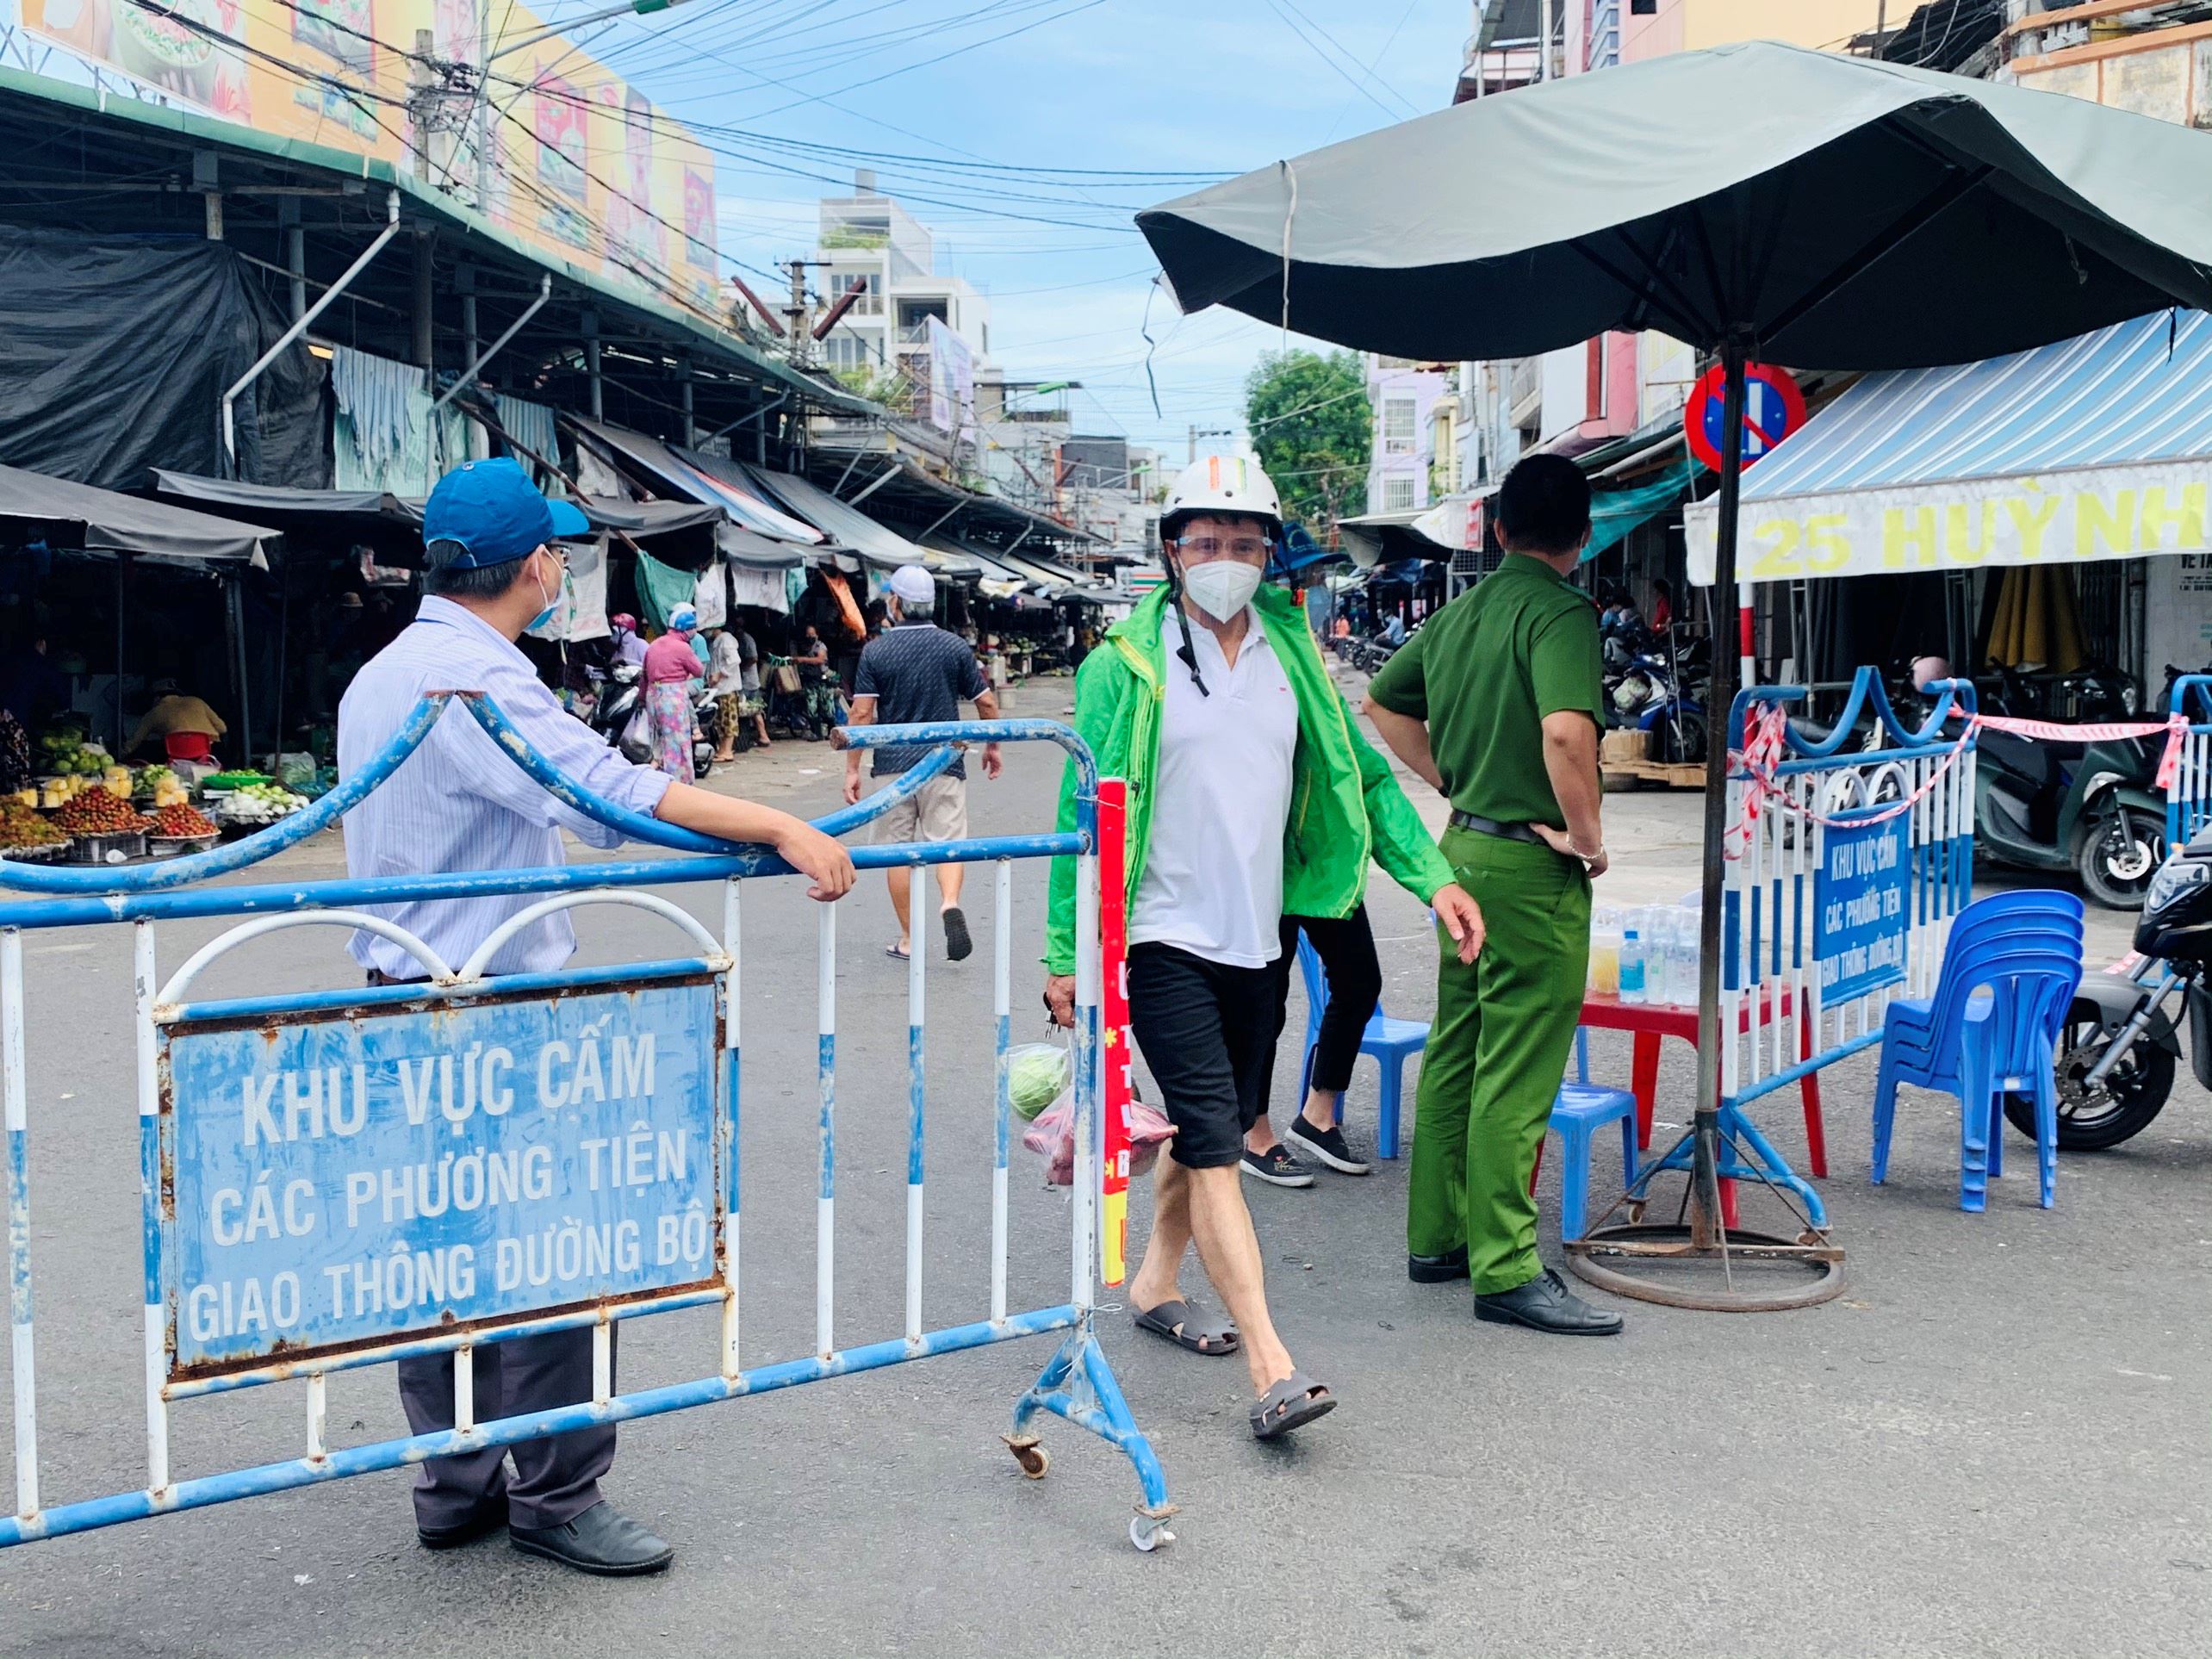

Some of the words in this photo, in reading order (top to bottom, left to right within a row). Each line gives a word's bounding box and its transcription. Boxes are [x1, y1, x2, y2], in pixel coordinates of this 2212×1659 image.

[1883, 477, 2207, 569] HUỲNH
[1831, 842, 1855, 881] KHU
[1856, 834, 1876, 881] VỰC
[1826, 896, 1843, 935] CÁC
[242, 1064, 366, 1146] KHU
[398, 1041, 514, 1135] VỰC
[538, 1013, 656, 1109] CẤM
[210, 1170, 315, 1247] CÁC
[347, 1146, 553, 1228] PHƯƠNG
[580, 1120, 687, 1197] TIỆN
[189, 1271, 301, 1343] GIAO
[324, 1235, 475, 1320] THÔNG
[495, 1216, 640, 1289] ĐƯỜNG
[657, 1196, 706, 1272] BỘ
